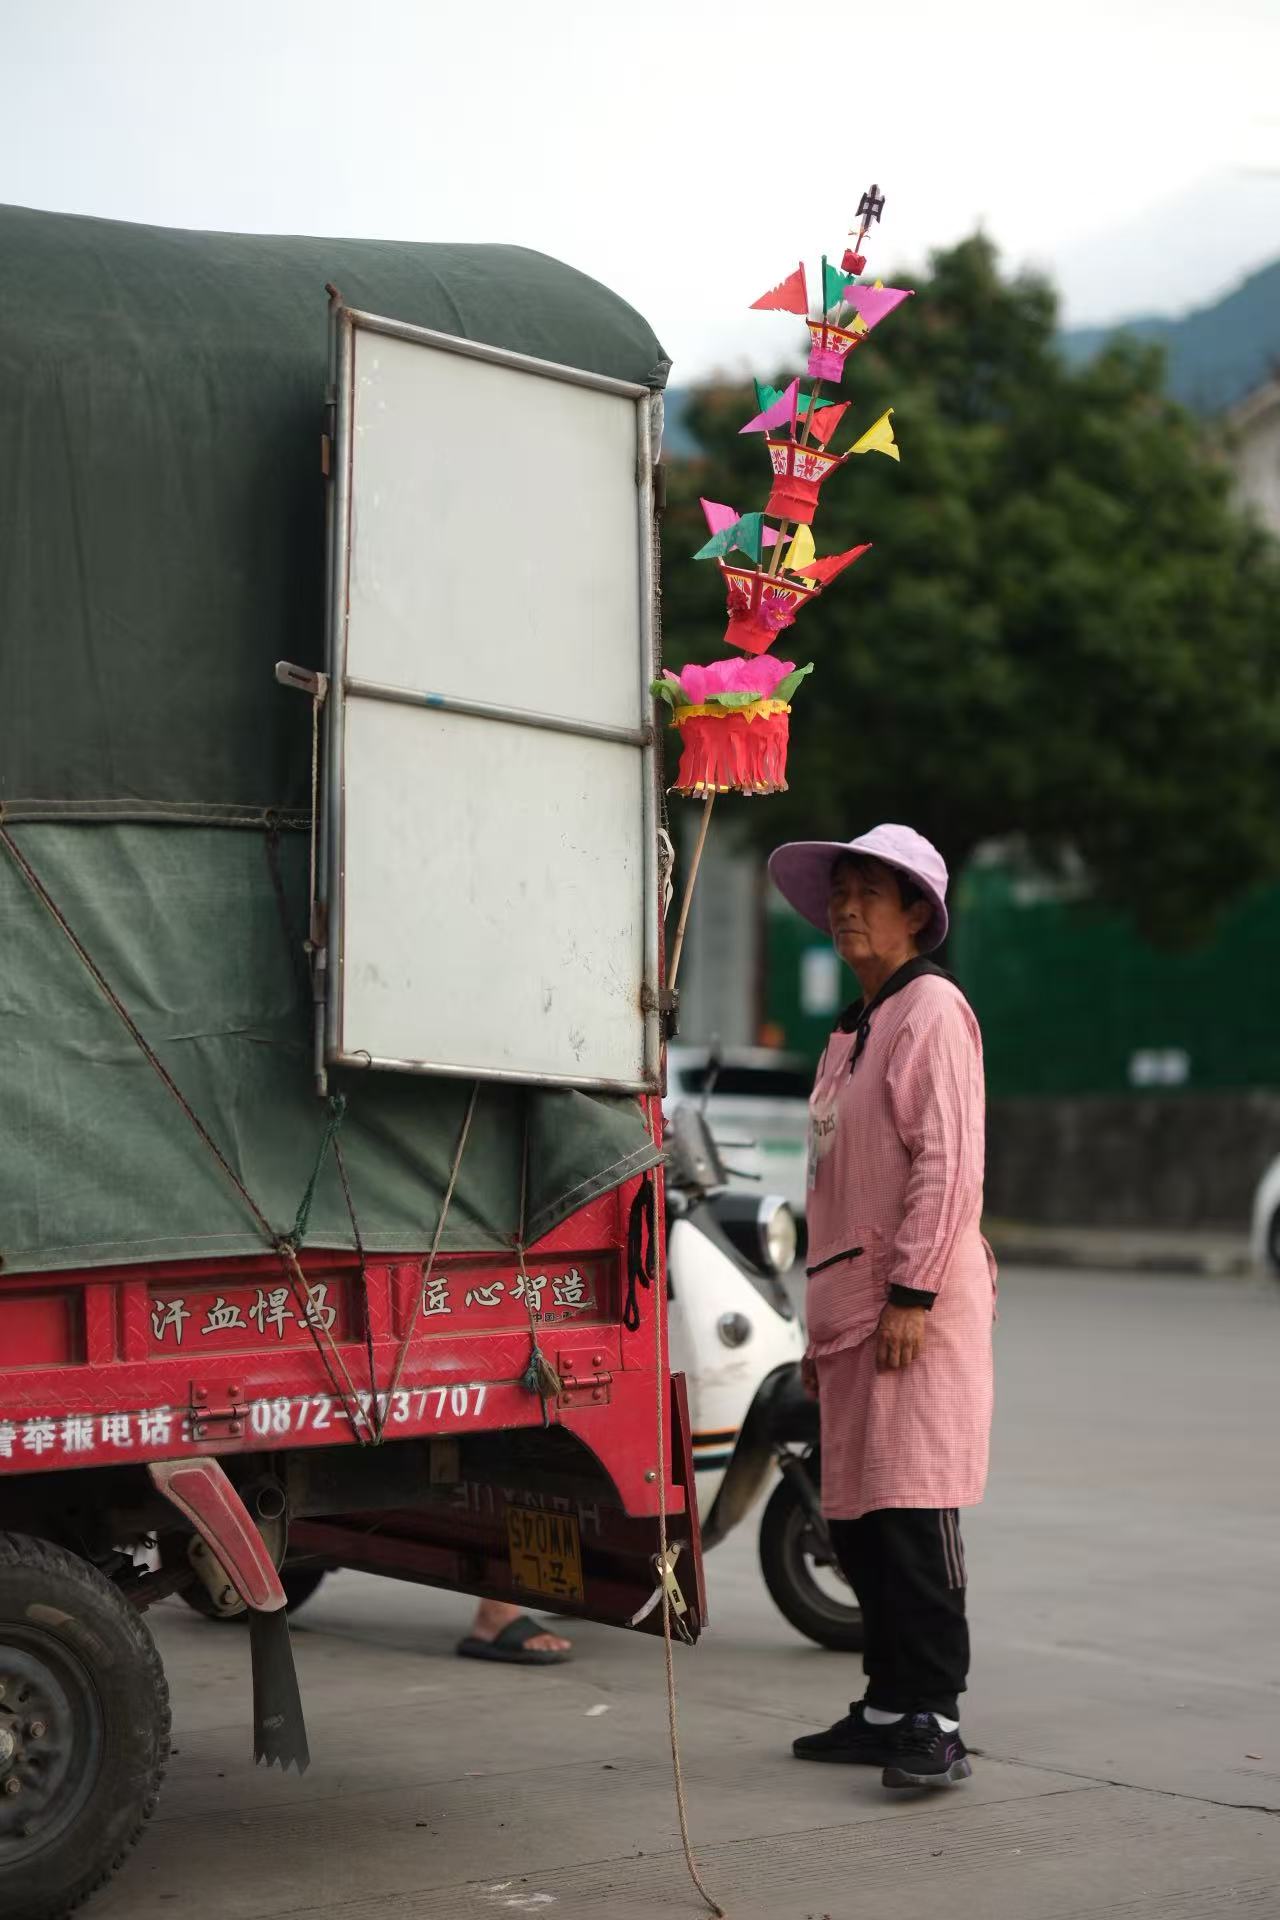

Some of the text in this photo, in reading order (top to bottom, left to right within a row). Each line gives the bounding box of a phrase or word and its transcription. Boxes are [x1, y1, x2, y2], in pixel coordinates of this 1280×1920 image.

[151, 1283, 337, 1345] 汗血悍马
[422, 1268, 594, 1317] 匠心智造
